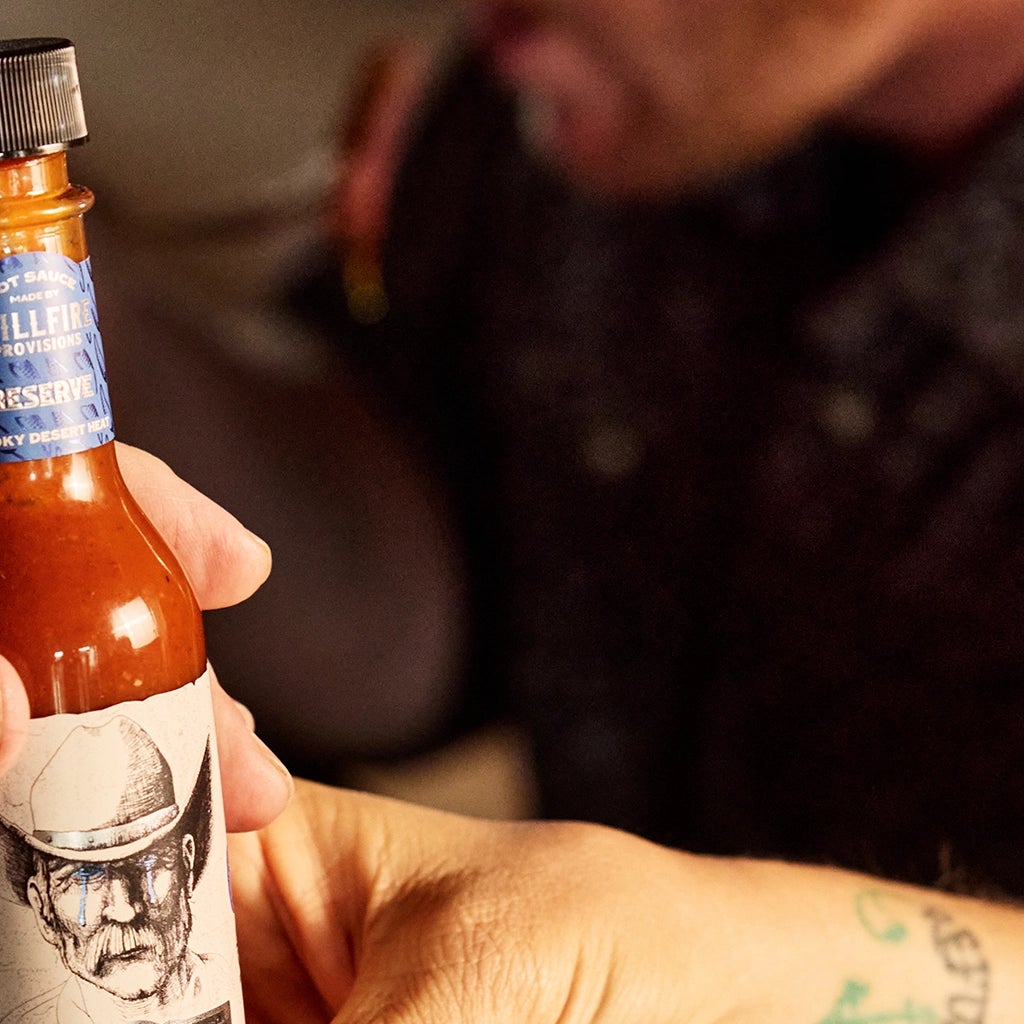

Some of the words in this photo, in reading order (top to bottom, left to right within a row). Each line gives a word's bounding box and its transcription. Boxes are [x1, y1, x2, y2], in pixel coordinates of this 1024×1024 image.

[23, 270, 76, 291] SAUCE
[9, 292, 44, 304] MADE
[44, 288, 59, 299] BY
[29, 424, 86, 445] DESERT
[87, 416, 110, 433] HEAT
